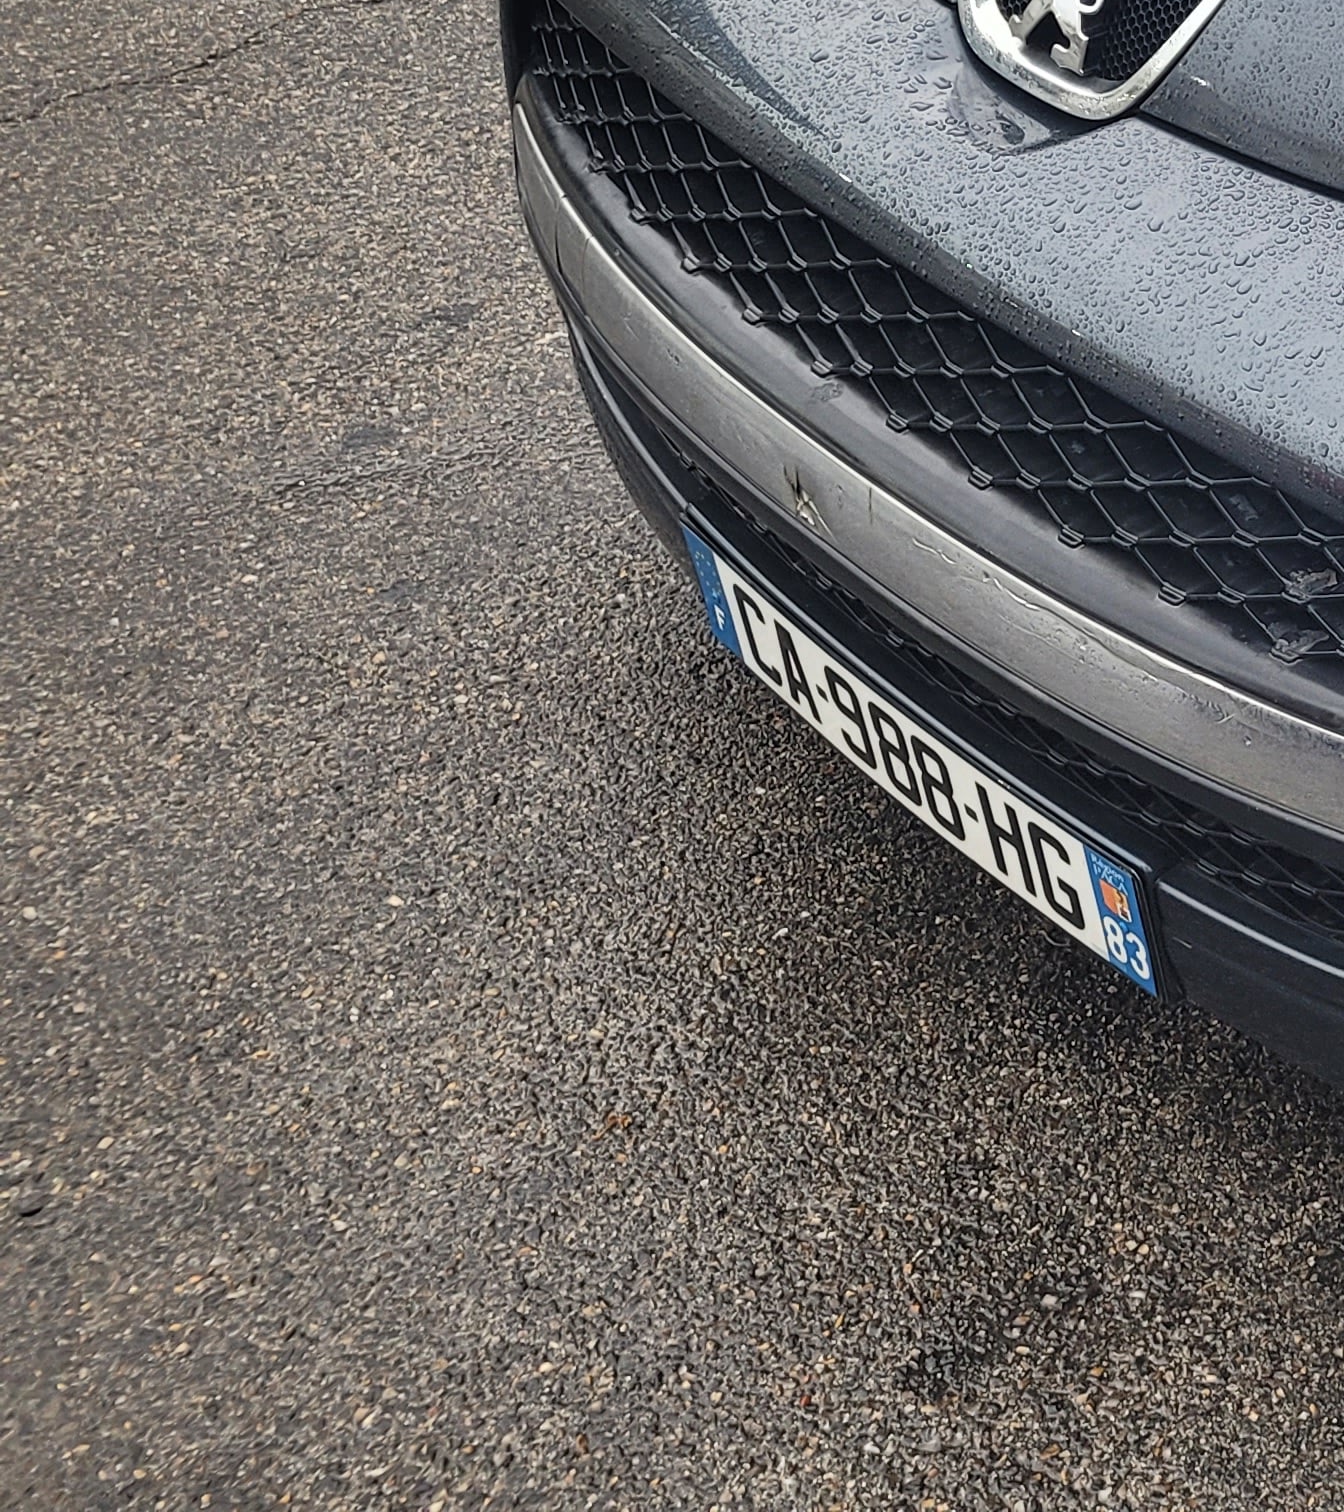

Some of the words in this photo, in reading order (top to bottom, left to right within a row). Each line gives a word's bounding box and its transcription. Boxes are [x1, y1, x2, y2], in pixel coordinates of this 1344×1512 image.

[714, 605, 725, 631] F
[732, 584, 1085, 930] CA-988-HG
[1103, 916, 1150, 980] 83
